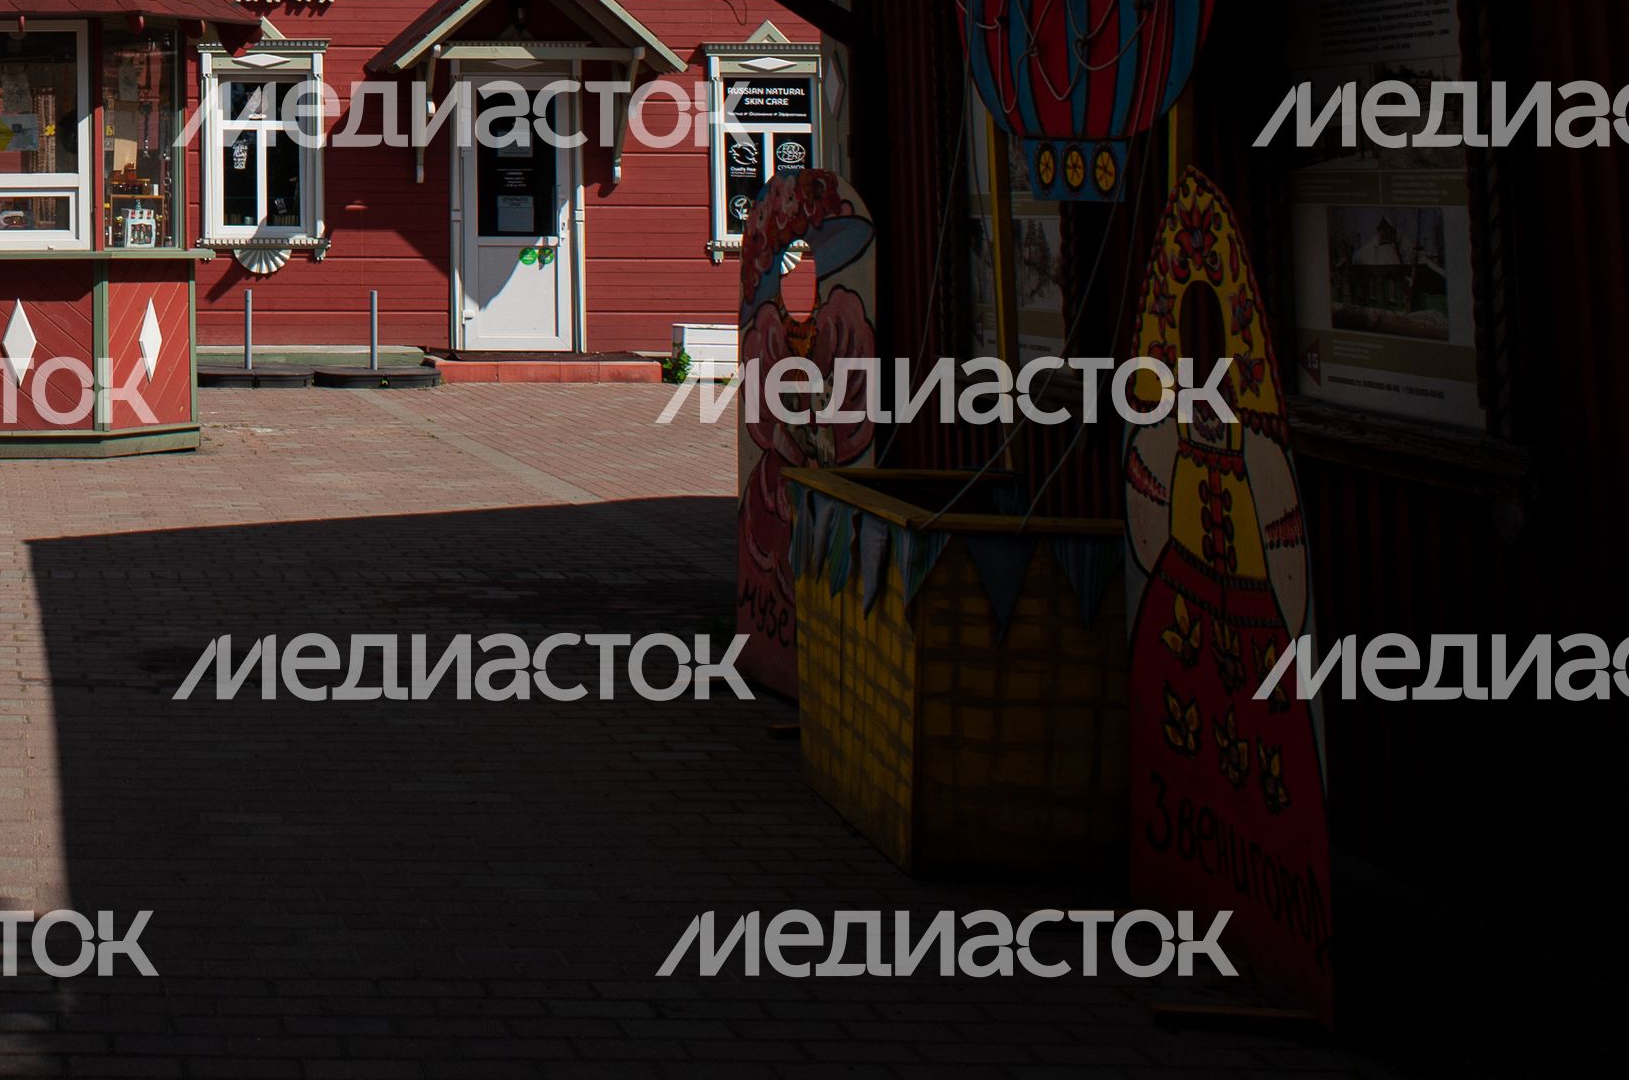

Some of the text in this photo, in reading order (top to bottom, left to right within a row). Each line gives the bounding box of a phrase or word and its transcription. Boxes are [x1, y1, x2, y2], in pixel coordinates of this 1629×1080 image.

[727, 87, 805, 96] RUSSIAN NATURAL
[744, 98, 789, 106] SKIN CARE
